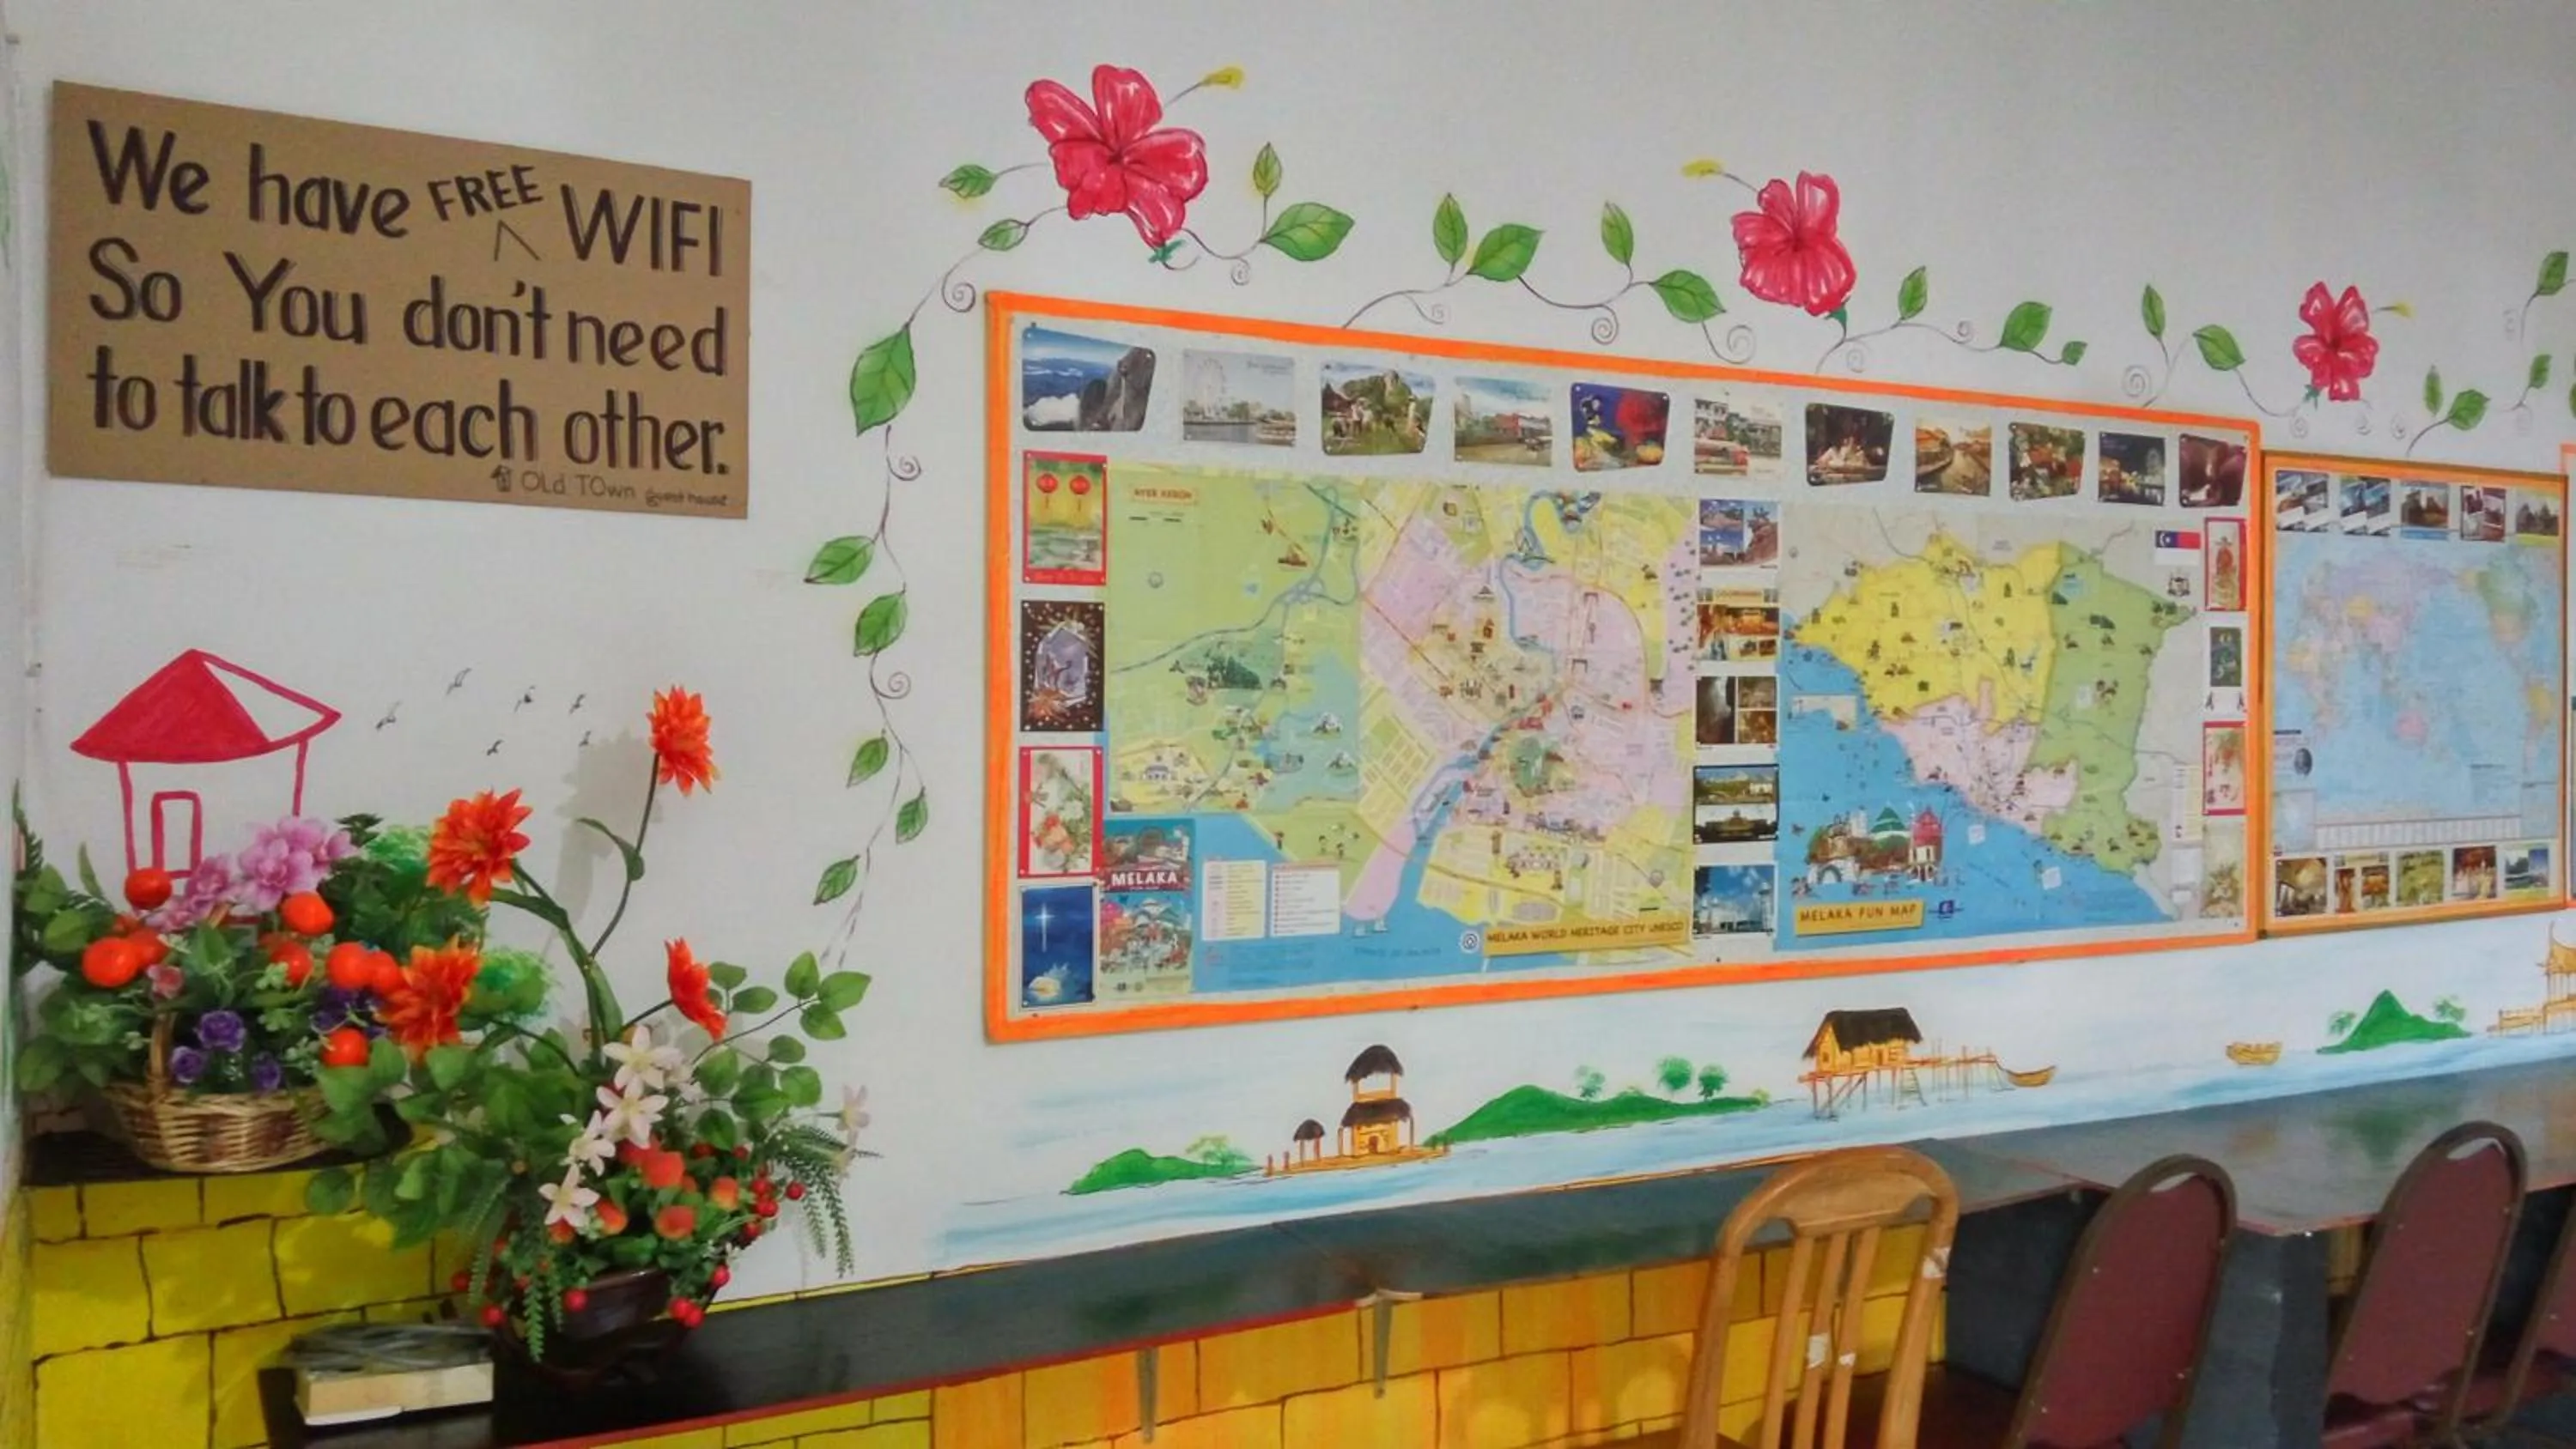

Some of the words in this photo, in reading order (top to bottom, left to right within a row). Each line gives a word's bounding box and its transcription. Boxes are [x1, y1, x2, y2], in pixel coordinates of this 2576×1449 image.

[88, 118, 210, 214] We
[248, 142, 410, 239] have
[428, 166, 544, 222] FREE
[561, 184, 723, 276] WIFI
[88, 237, 182, 323] So
[223, 251, 368, 344] You
[403, 275, 550, 359] don't
[567, 306, 728, 376] need
[88, 345, 157, 431] to
[174, 354, 289, 444] talk
[297, 365, 355, 446] to
[371, 379, 538, 461] each
[563, 390, 730, 475] other.
[1111, 871, 1177, 886] MELAKA
[1800, 908, 1853, 922] MELAKA
[1858, 906, 1884, 919] FUN
[1890, 903, 1918, 916] MAP
[1487, 930, 1528, 943] MELAKA
[1532, 929, 1567, 940] WORLD
[1571, 925, 1619, 937] HERITAGE
[1623, 924, 1646, 934] CITY
